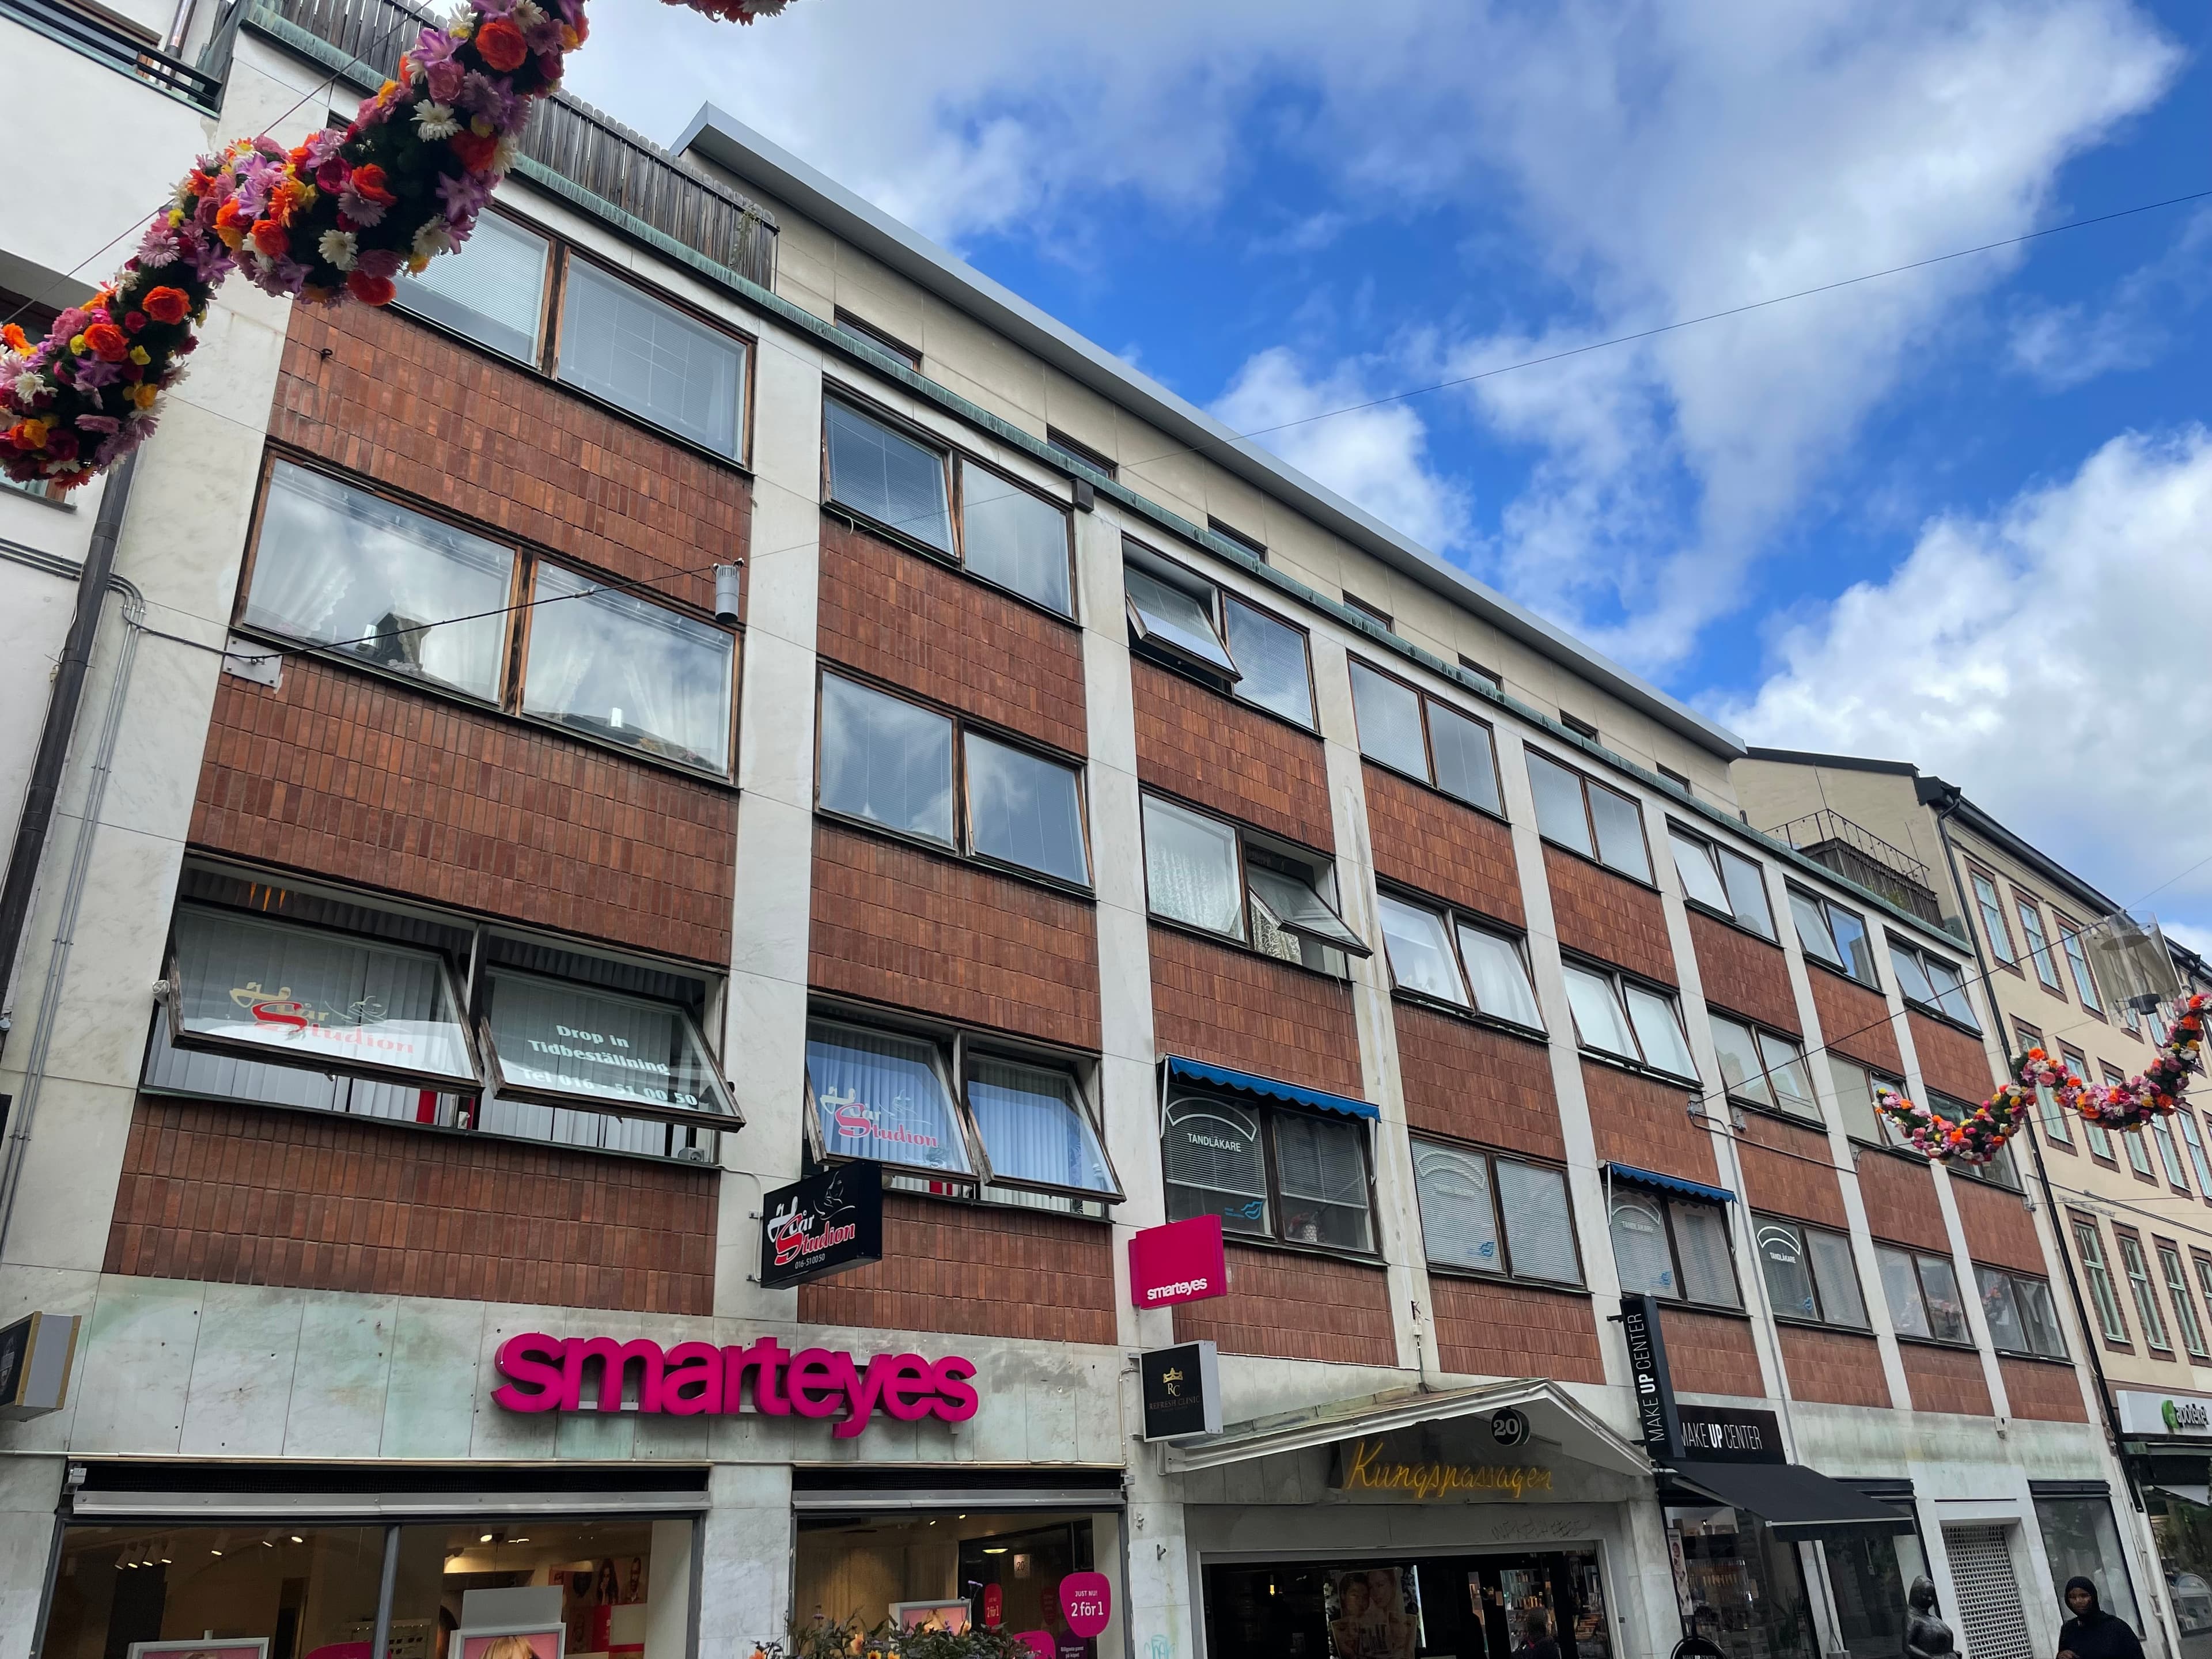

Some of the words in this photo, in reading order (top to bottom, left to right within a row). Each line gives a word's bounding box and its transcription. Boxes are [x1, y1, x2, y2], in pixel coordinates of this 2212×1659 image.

[252, 1001, 414, 1054] Studion
[556, 1025, 604, 1044] Drop
[609, 1035, 629, 1048] in
[528, 1040, 671, 1076] Tidbeställning
[521, 1068, 551, 1083] Tel
[558, 1074, 594, 1089] 016
[615, 1083, 635, 1096] 51
[643, 1088, 668, 1101] 00
[674, 1092, 698, 1106] 50
[835, 1103, 939, 1147] Studion
[1187, 1133, 1241, 1152] TANDLÄKARE
[774, 1212, 855, 1266] Studion
[1147, 1278, 1207, 1300] smarteyes
[1627, 1313, 1652, 1370] CENTER
[490, 1332, 978, 1439] smarteyes
[1638, 1373, 1656, 1394] UP
[1493, 1418, 1519, 1437] 20
[1643, 1397, 1665, 1442] MAKE
[1708, 1423, 1723, 1448] UP
[1724, 1425, 1763, 1450] CENTER
[1346, 1441, 1554, 1498] Kungspassagen
[1071, 1602, 1078, 1616] 2
[1080, 1601, 1096, 1616] för
[1098, 1601, 1104, 1615] 1
